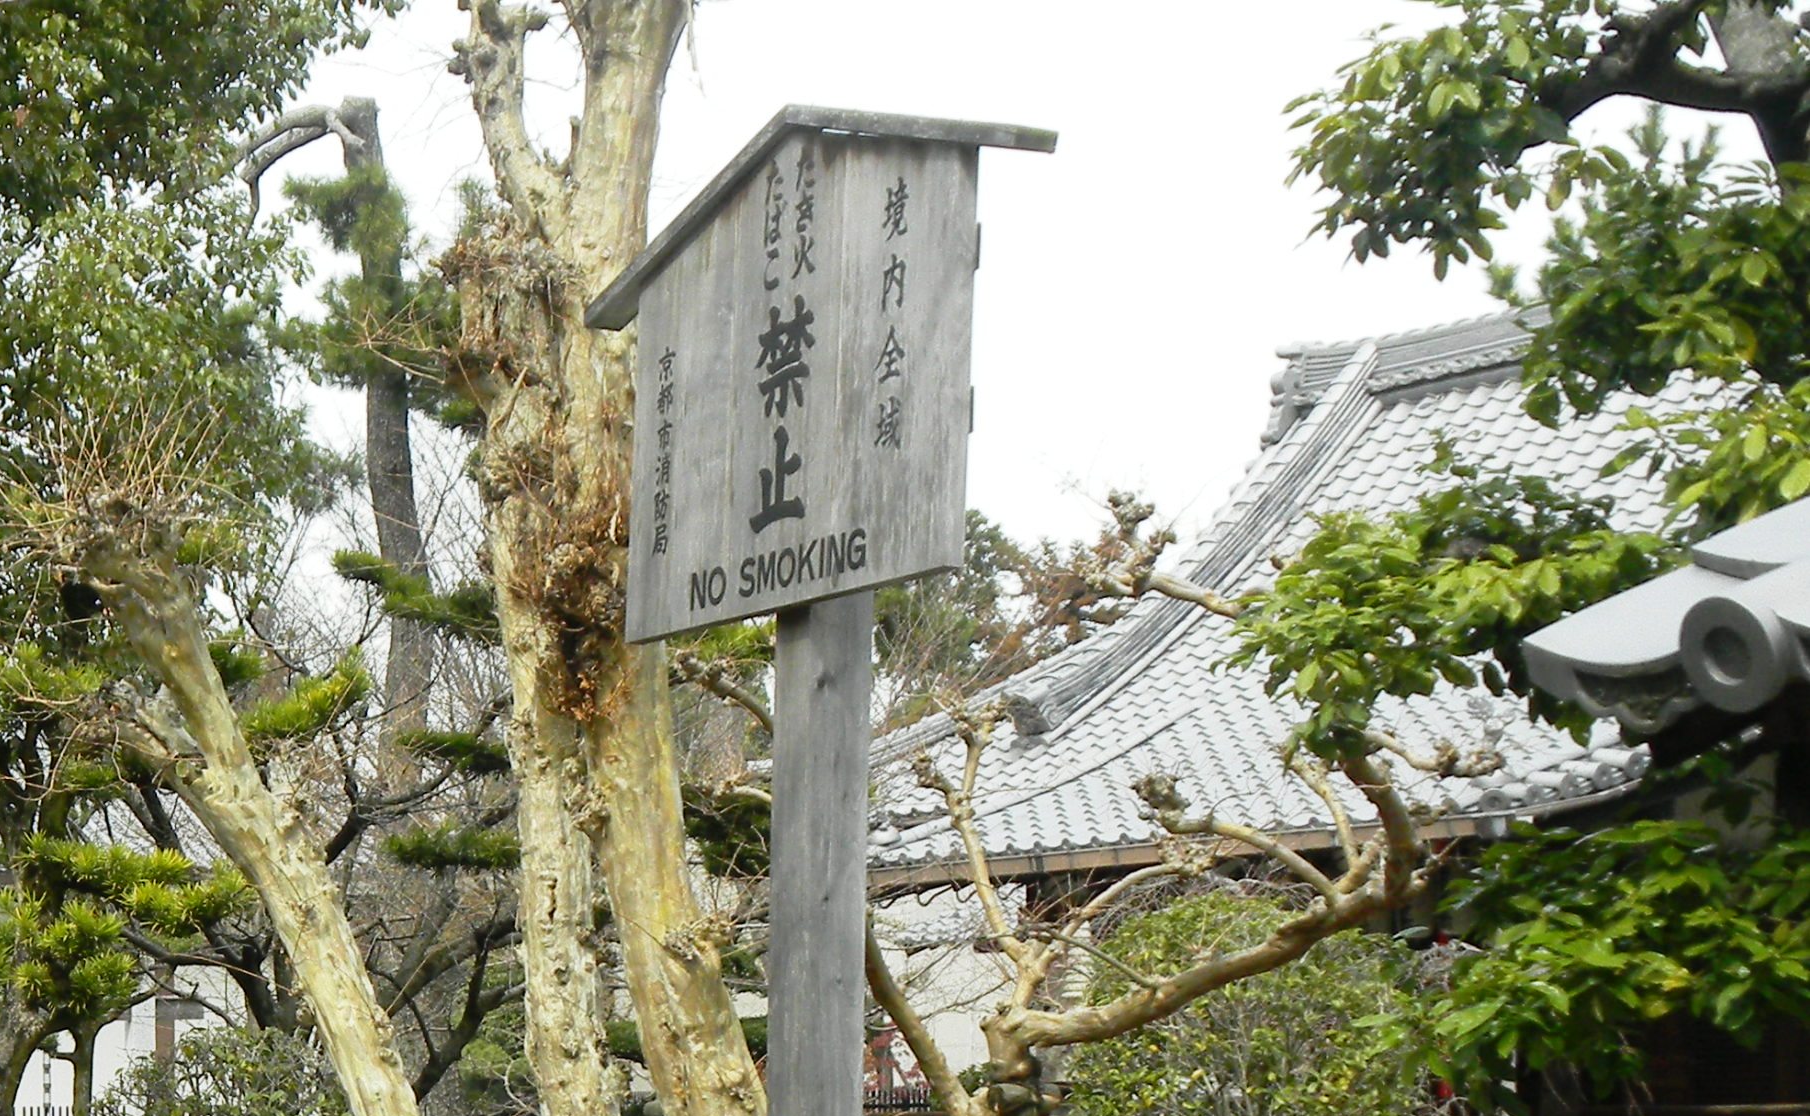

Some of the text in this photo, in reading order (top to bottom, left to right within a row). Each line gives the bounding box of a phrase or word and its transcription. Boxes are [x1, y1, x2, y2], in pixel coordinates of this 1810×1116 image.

[762, 160, 785, 291] たばこ
[792, 148, 816, 280] たき火
[873, 177, 910, 450] 境内全域
[651, 346, 677, 557] 京都市消防局
[749, 294, 816, 535] 禁止
[690, 528, 868, 612] NO SMOKING
